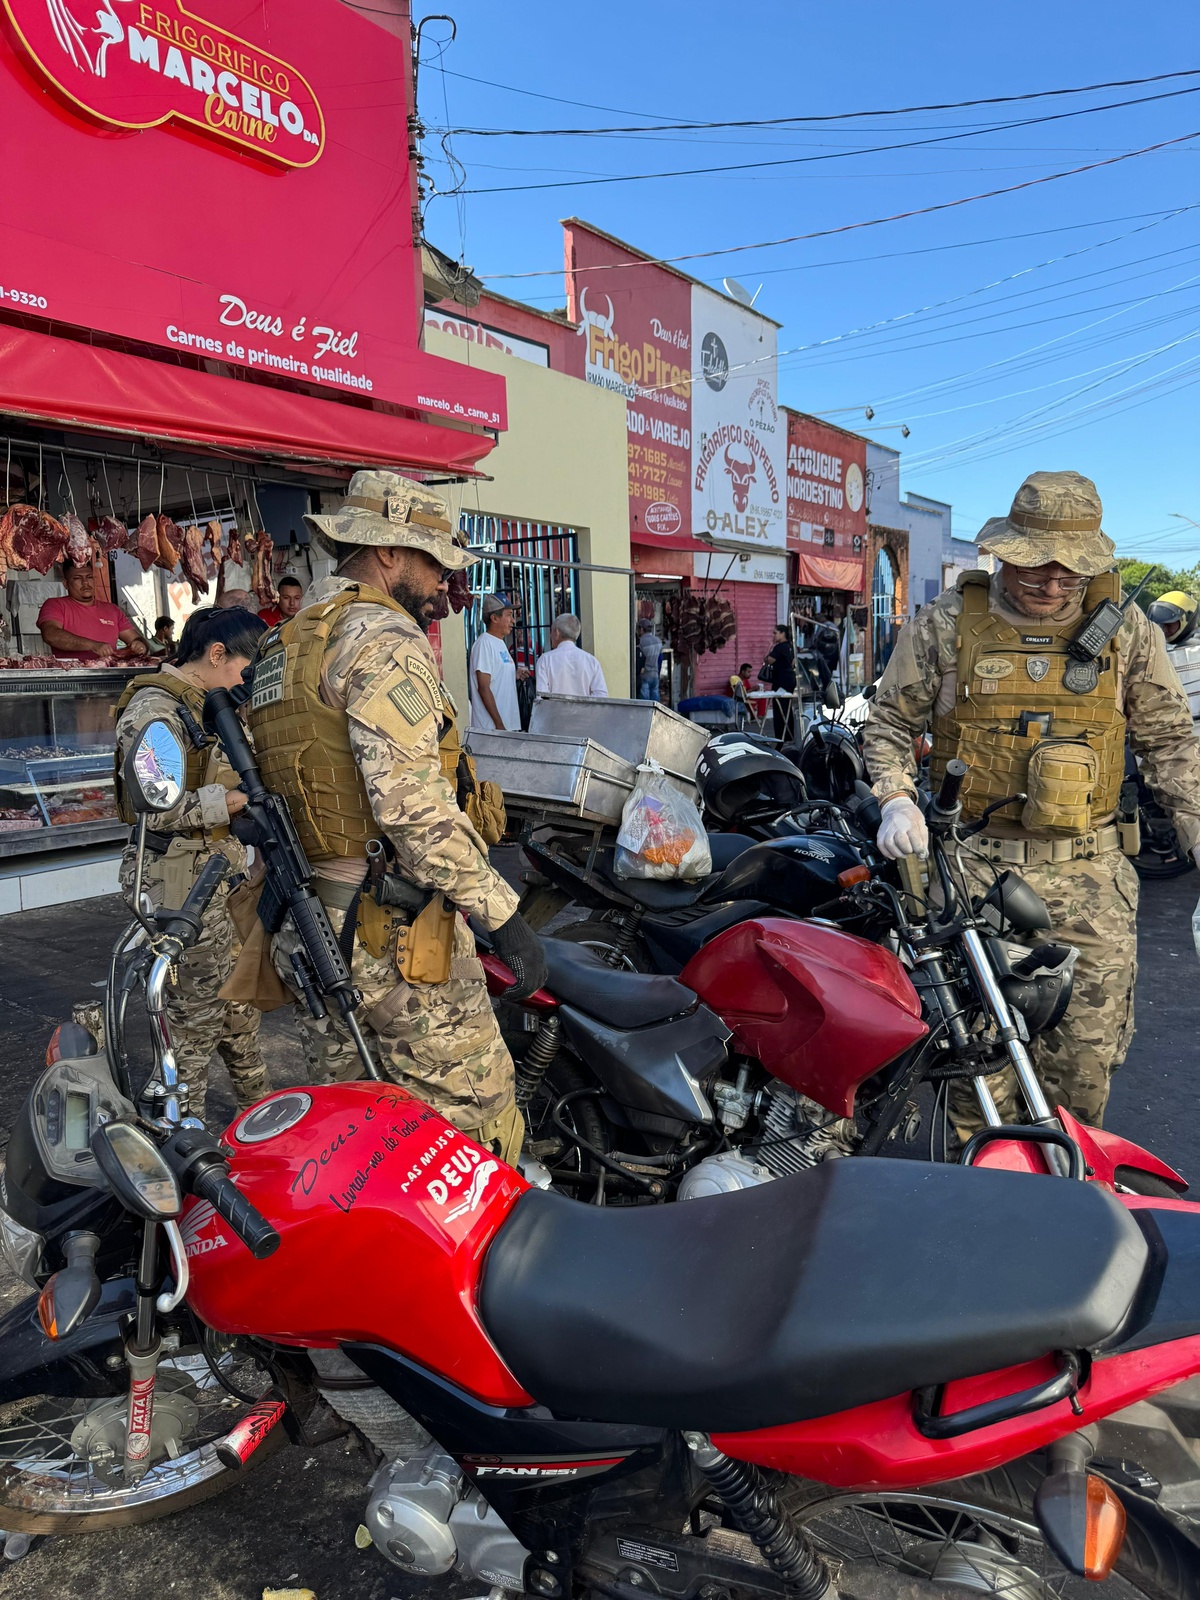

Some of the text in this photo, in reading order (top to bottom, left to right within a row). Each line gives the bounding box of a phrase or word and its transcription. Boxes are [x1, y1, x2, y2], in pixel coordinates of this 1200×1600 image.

[139, 3, 290, 93] FRIGORIFICO
[128, 25, 304, 135] MARCELO
[204, 93, 277, 143] Carne
[303, 128, 319, 146] DA
[219, 294, 359, 360] Deus é Fiel
[650, 318, 673, 344] Deus
[166, 325, 373, 391] Carnes de primeira qualidade
[417, 395, 500, 423] marcelo_da_carne_51
[650, 416, 691, 450] VAREJO
[695, 421, 780, 504] FRIGORÍFICO SÃO PEDRO
[787, 443, 843, 484] AÇOUGUE
[787, 475, 844, 510] NORDESTINO
[706, 509, 717, 531] O
[721, 512, 769, 540] ALEX
[409, 660, 442, 707] FORÇA ESTADUAL
[793, 848, 830, 865] HONDA
[380, 1135, 400, 1152] de
[390, 1117, 421, 1138] todo
[291, 1123, 359, 1195] Deus
[426, 1145, 481, 1205] DEUS
[132, 1398, 146, 1431] TATA
[475, 1466, 540, 1476] FAN
